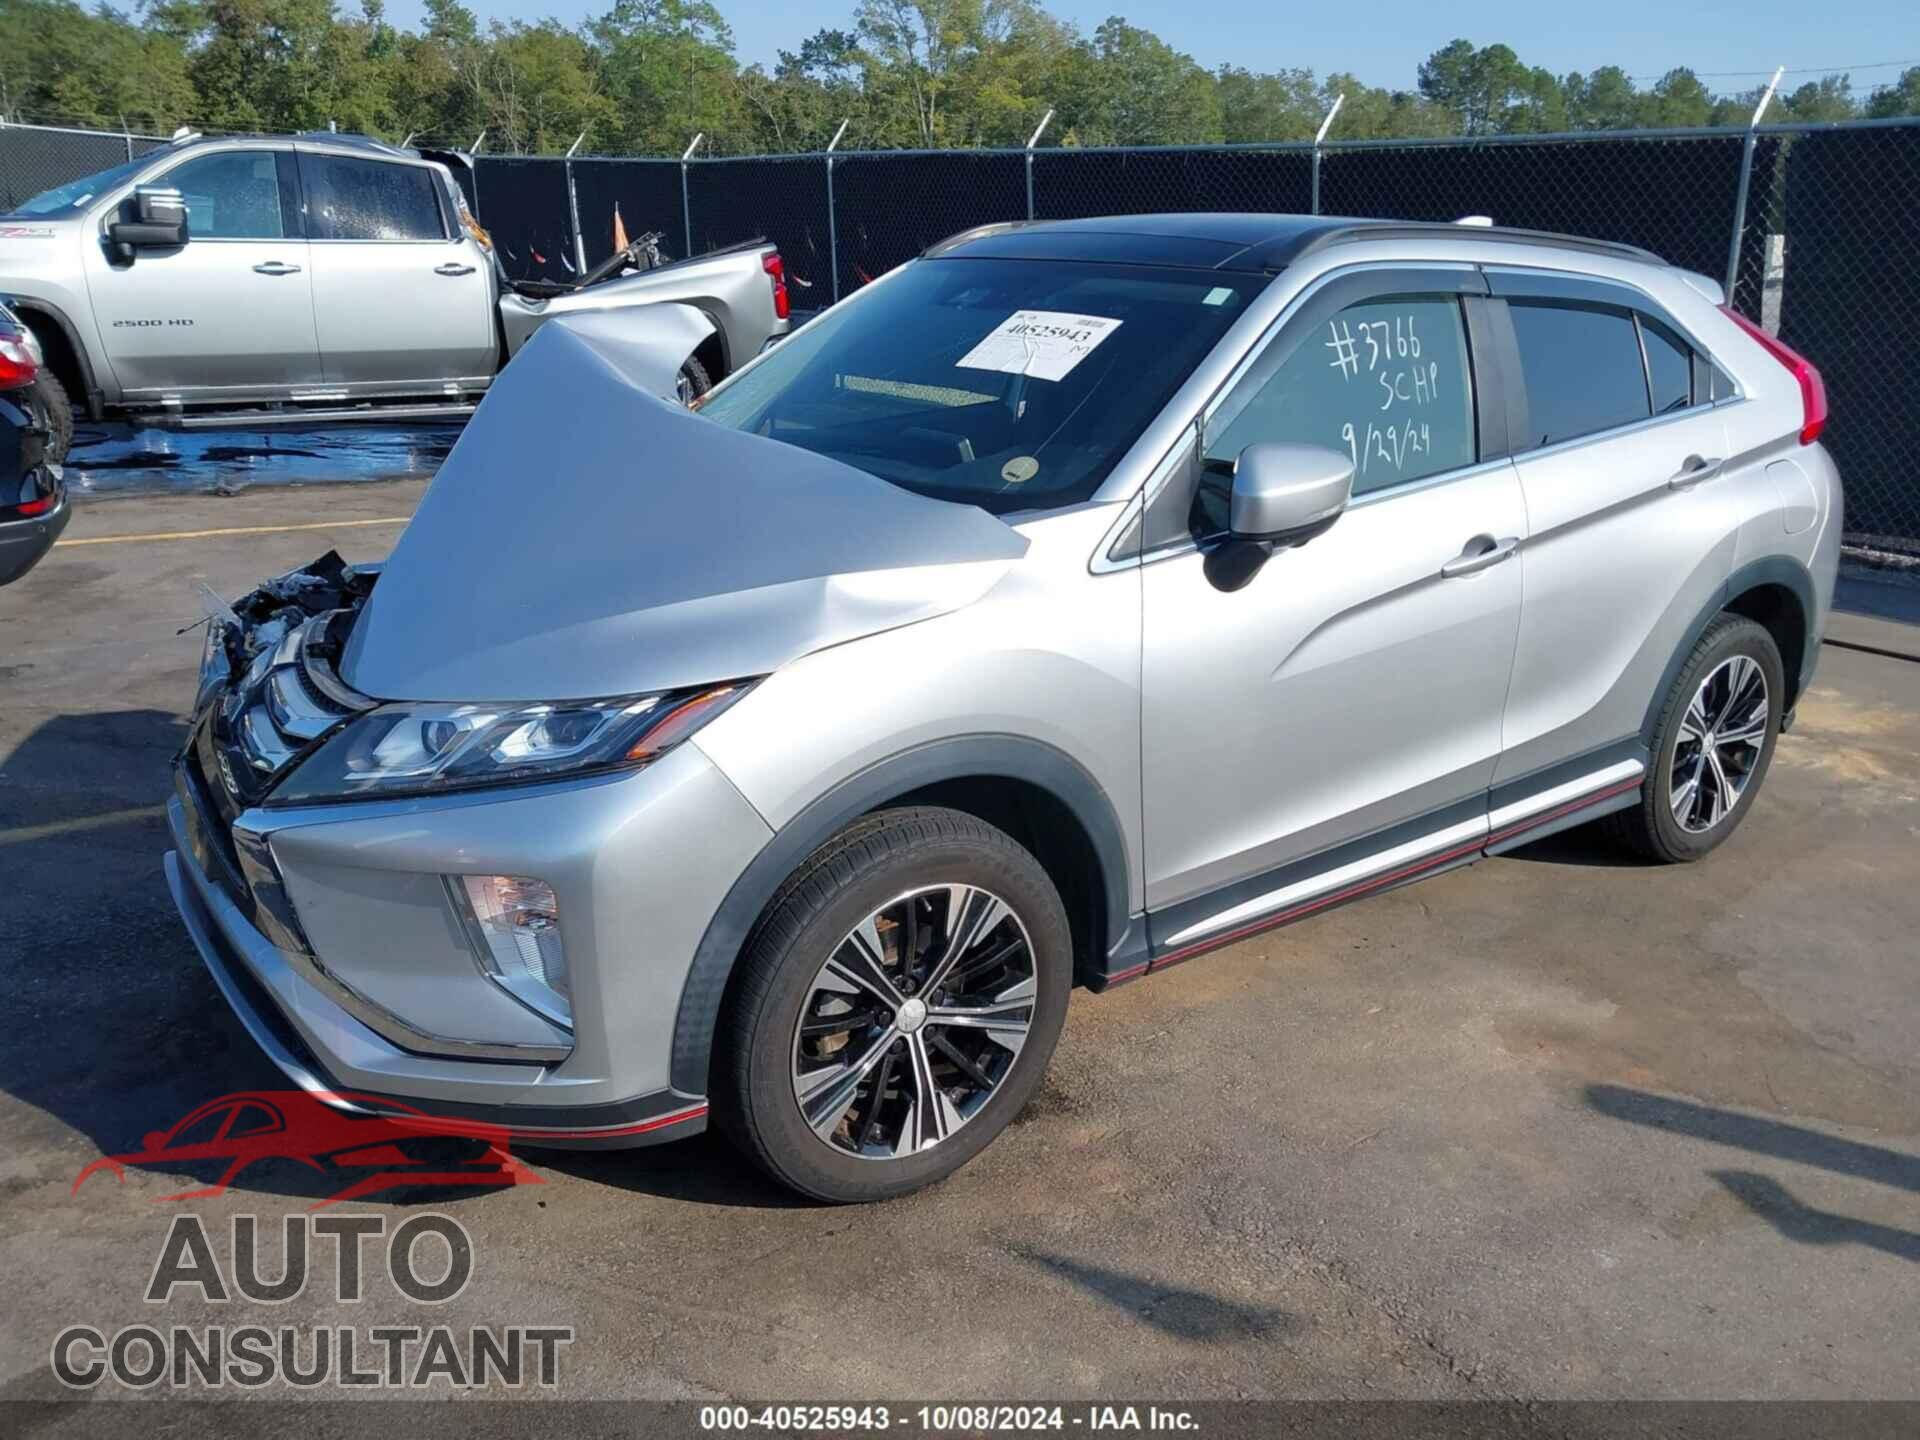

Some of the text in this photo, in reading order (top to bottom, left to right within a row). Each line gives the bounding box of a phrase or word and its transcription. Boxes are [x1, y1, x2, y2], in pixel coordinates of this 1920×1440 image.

[112, 318, 195, 328] 2500 HD
[1006, 323, 1093, 343] 40525943
[1325, 315, 1421, 383] #3766
[1380, 361, 1438, 410] SCHP
[1342, 417, 1430, 474] 9/29/24
